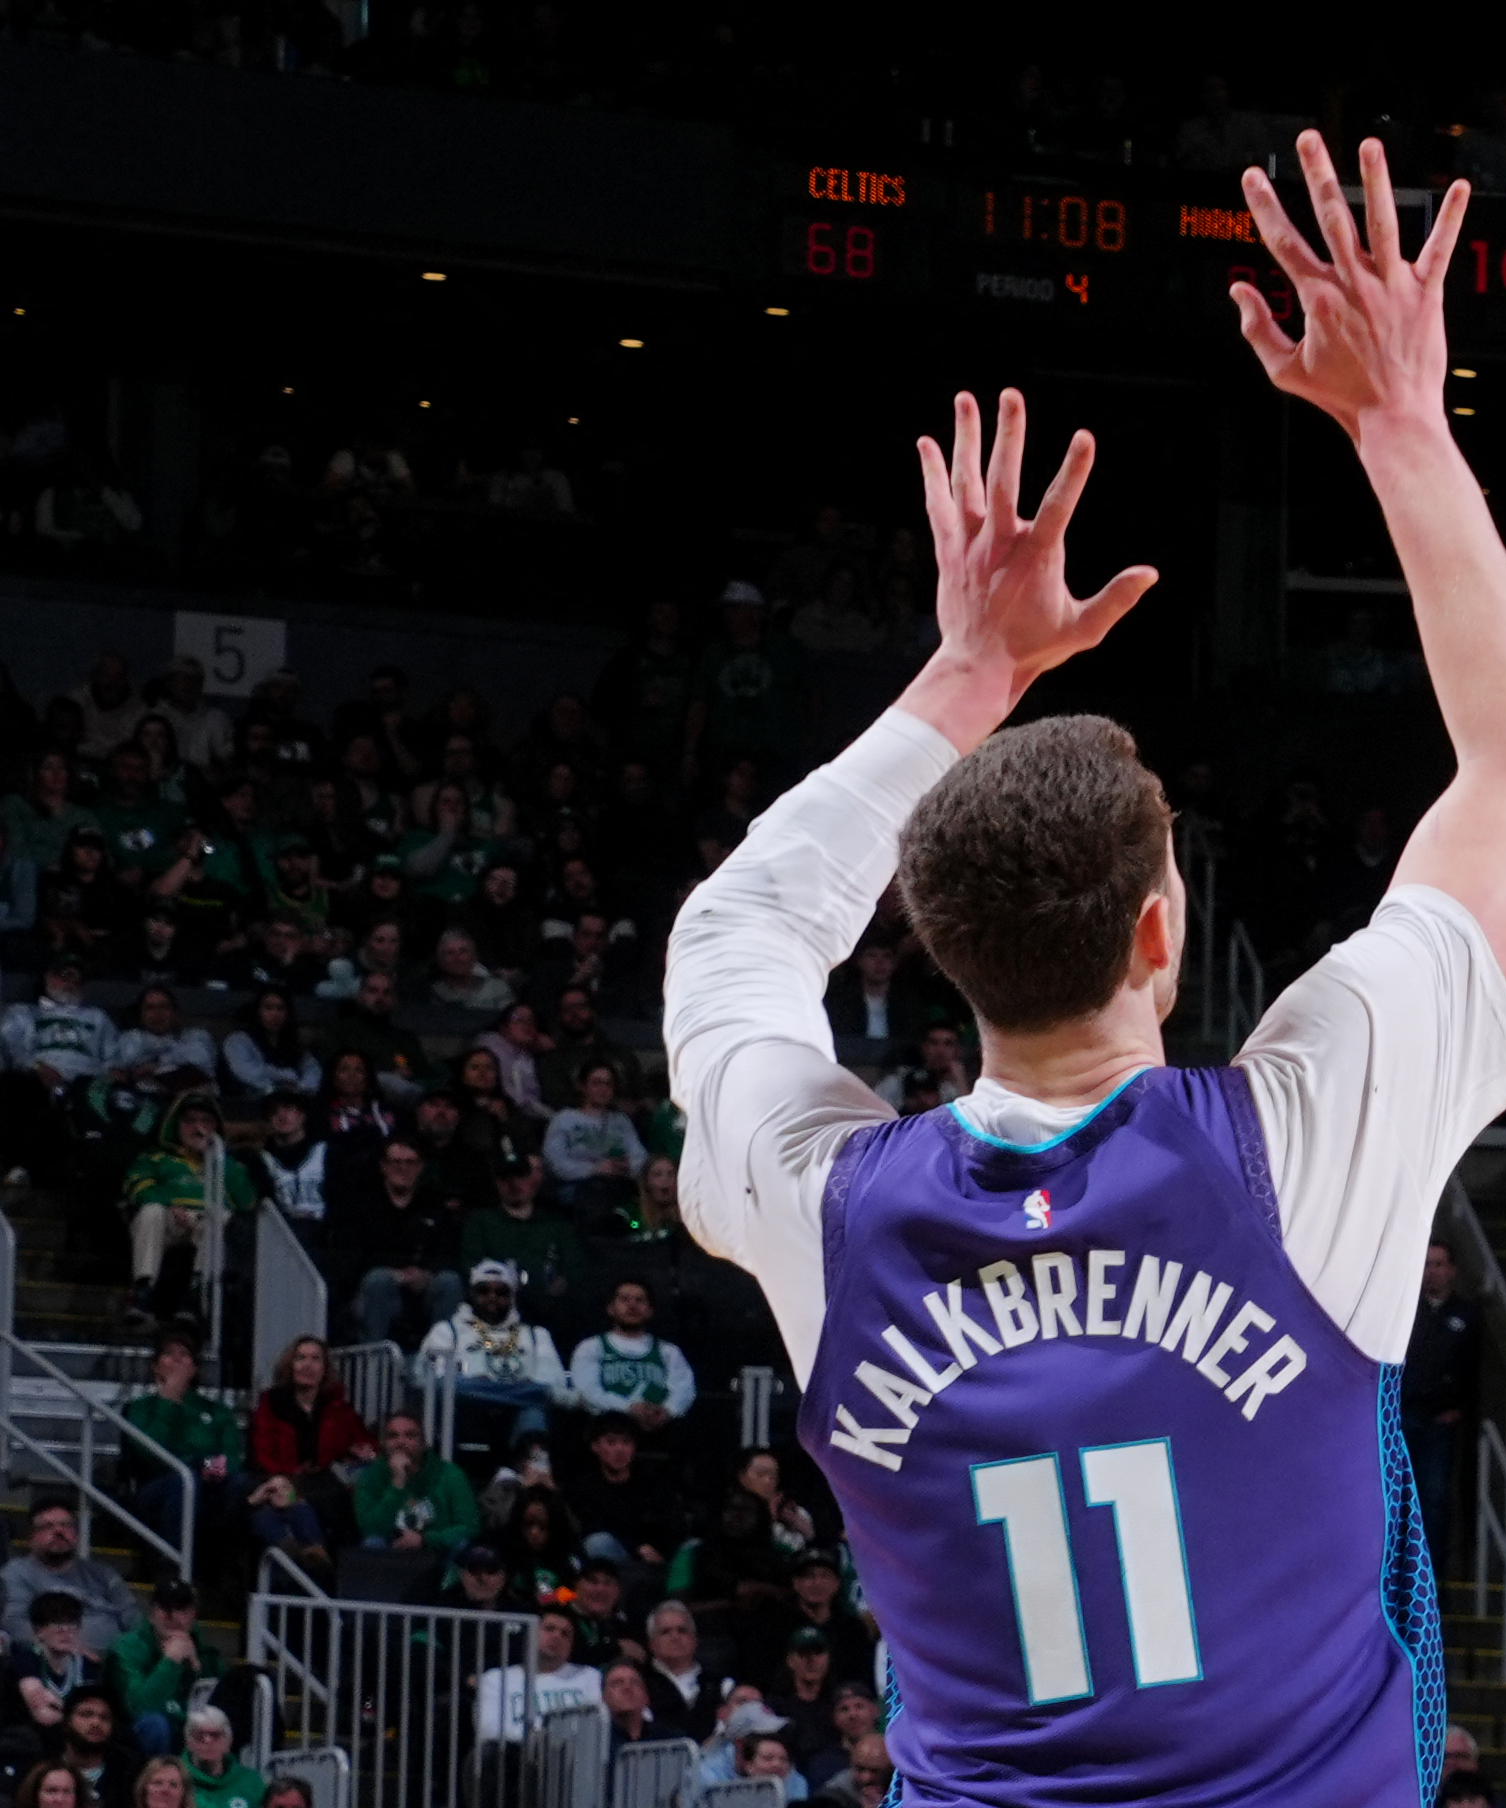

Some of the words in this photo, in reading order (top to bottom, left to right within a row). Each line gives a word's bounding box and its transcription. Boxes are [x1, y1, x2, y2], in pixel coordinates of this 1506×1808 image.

[808, 166, 906, 208] CELTICS
[806, 222, 876, 278] 68
[984, 191, 1127, 253] 11:08
[1179, 204, 1266, 246] HORNE
[975, 272, 1056, 302] PERIOD
[1065, 273, 1090, 305] 4
[213, 626, 245, 685] 5
[830, 1250, 1307, 1472] KALKBRENNER
[969, 1436, 1204, 1706] 11
